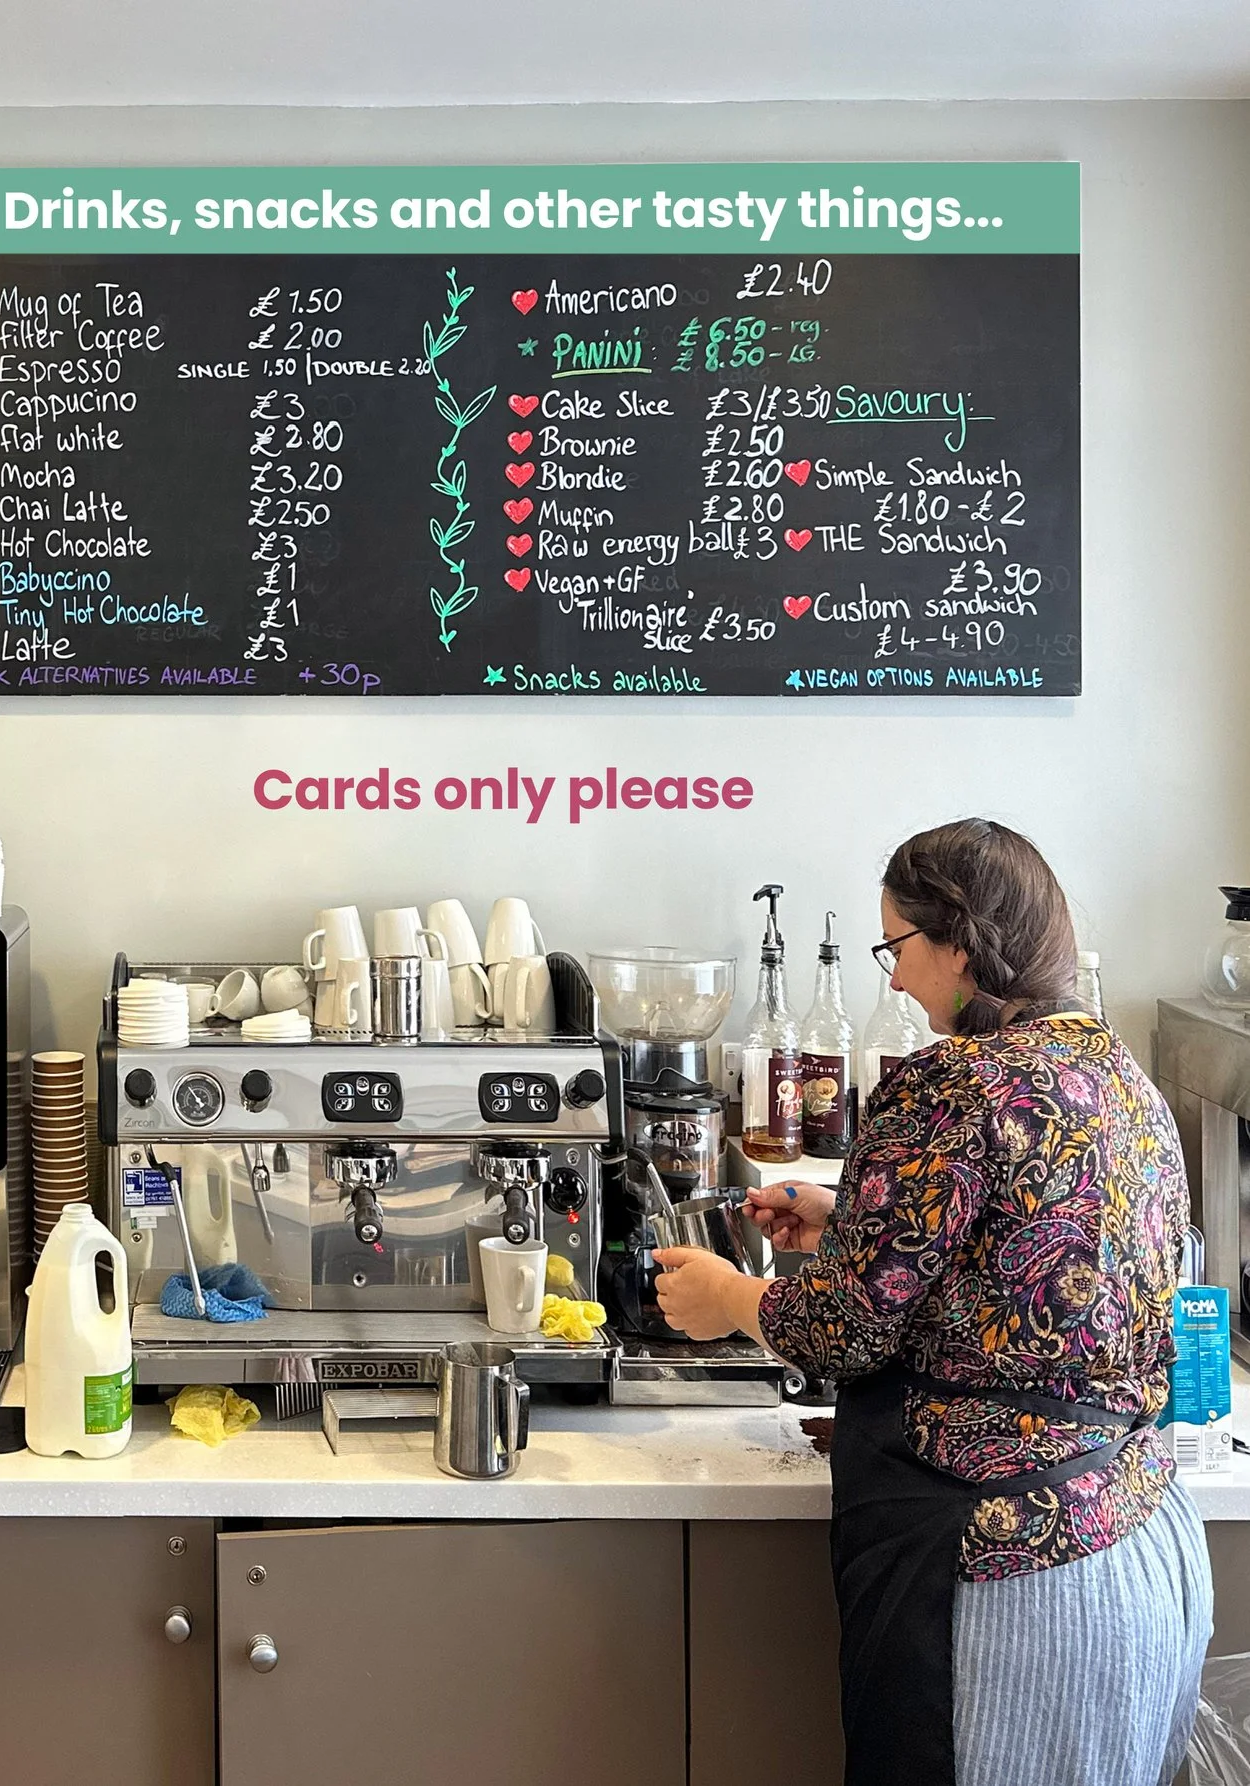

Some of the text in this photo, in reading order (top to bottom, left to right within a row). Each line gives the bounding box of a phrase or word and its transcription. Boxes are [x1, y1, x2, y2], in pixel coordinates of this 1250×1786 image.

[5, 186, 1003, 241] Drinks, snacks and other tasty things...
[545, 258, 834, 316] Americano £2.40
[58, 291, 82, 330] of
[95, 283, 144, 318] Tea
[78, 320, 165, 359] Coffee
[177, 362, 250, 379] SINGLE
[0, 389, 137, 426] Cappucino
[541, 389, 604, 420] Cake
[617, 390, 676, 419] Slice
[835, 383, 974, 453] Savoury:
[56, 422, 124, 452] white
[539, 426, 637, 457] Brownie
[0, 461, 343, 494] Mocha £3.20
[539, 461, 627, 491] Blondie
[814, 457, 1022, 493] Simple Sandwich
[0, 495, 331, 527] Chai Latte £2.50
[538, 493, 784, 533] Muffin £2.80
[0, 528, 298, 561] Hot Chocolate £3
[538, 531, 589, 560] Raw
[605, 532, 680, 566] energy
[688, 521, 735, 554] ball
[815, 523, 1007, 555] THE Sandwich
[257, 562, 297, 597] £1
[943, 560, 1042, 596] £3.90
[0, 593, 299, 642] Tiny Hot Chocolate £1
[814, 583, 1038, 622] Custom sandwich
[699, 606, 776, 641] £3.50
[1, 629, 288, 662] Latte £3
[18, 665, 151, 688] ALTERNATIVES
[160, 666, 258, 687] AVAILABLE
[513, 664, 708, 692] Snacks available
[804, 666, 1044, 688] VEGAN OPTIONS AVAILABLE
[253, 767, 754, 824] Cards only please
[124, 1117, 156, 1128] Zircon
[322, 1362, 418, 1379] EXPOBAR
